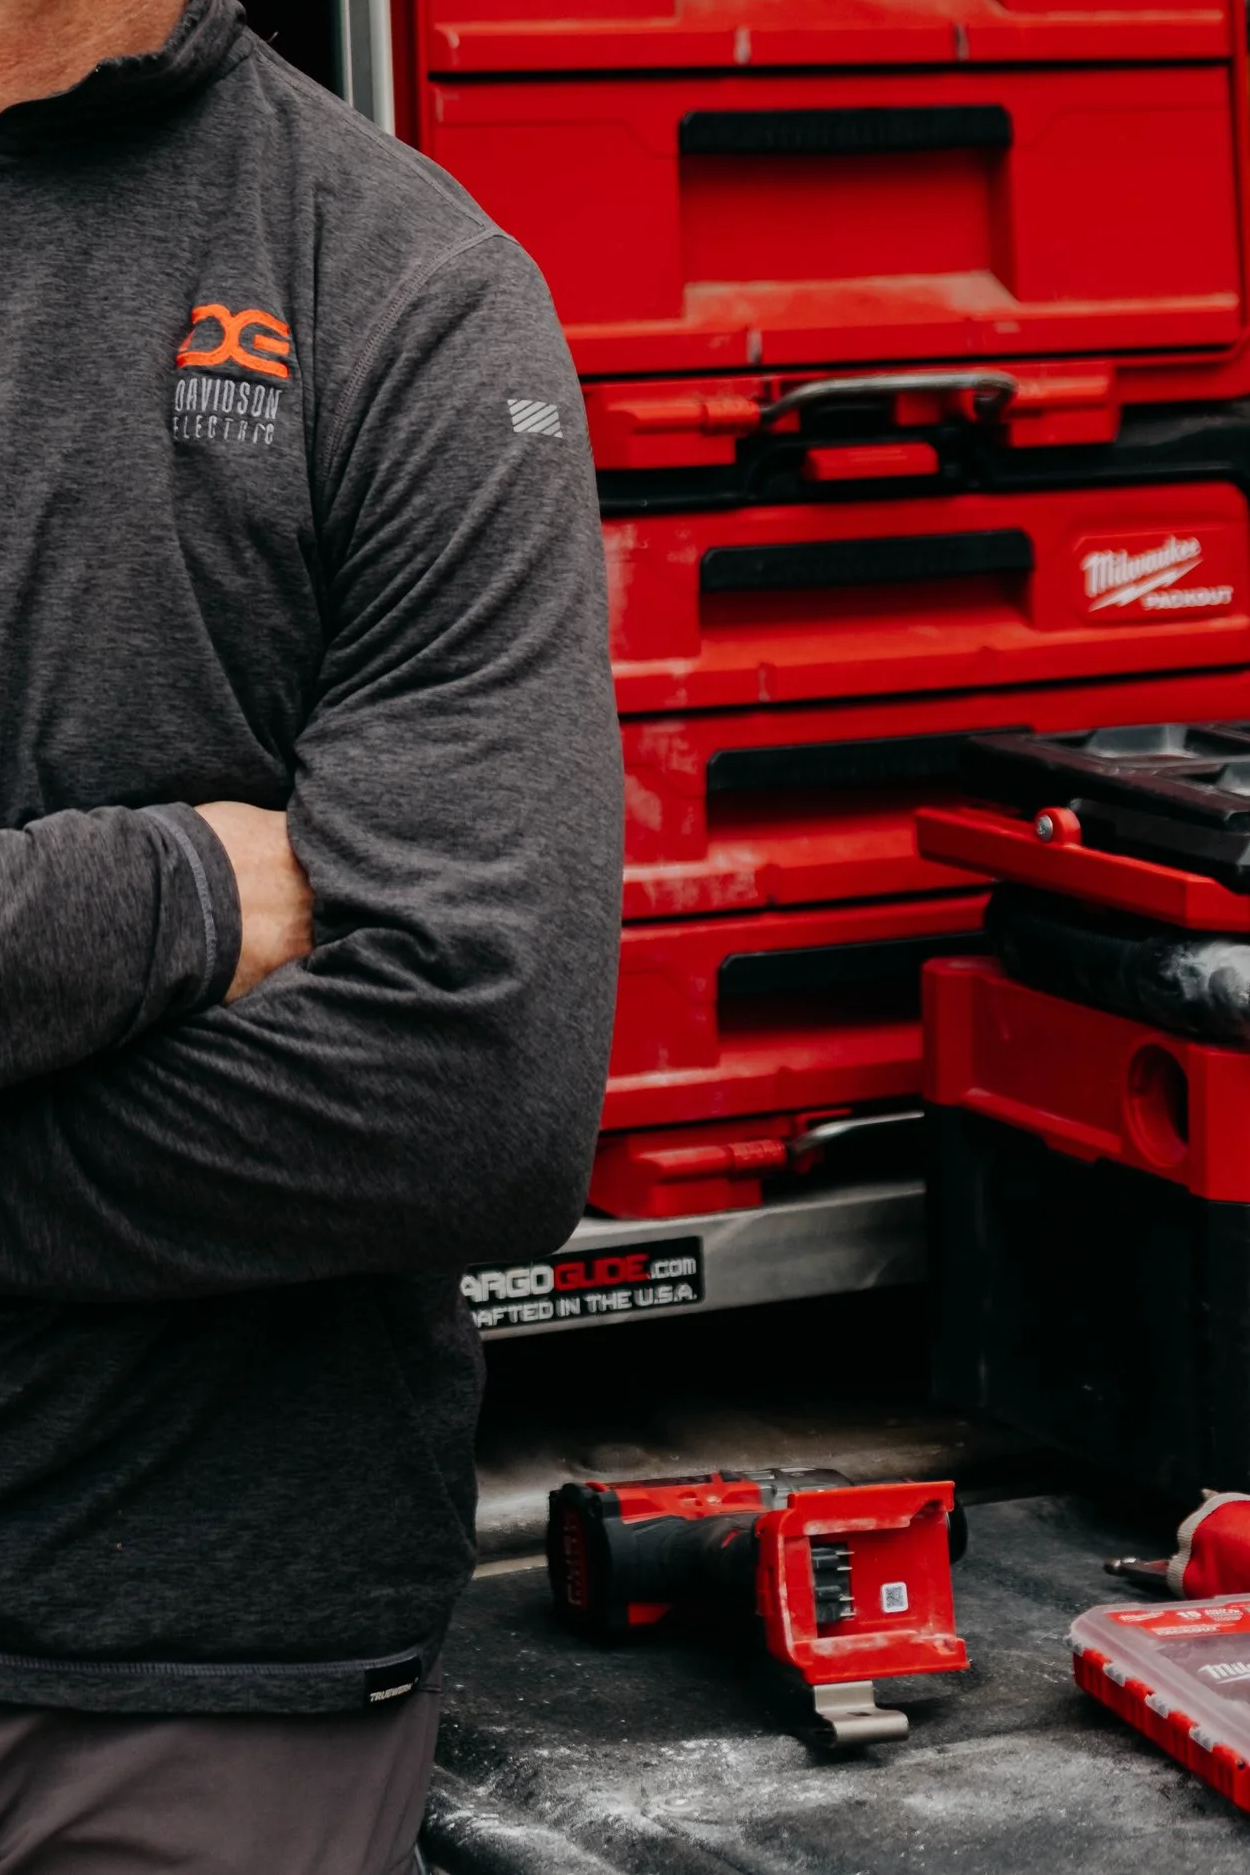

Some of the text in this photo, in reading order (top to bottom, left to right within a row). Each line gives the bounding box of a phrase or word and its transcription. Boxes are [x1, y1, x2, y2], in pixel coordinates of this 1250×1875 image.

[174, 377, 283, 420] DAVIDSON
[172, 415, 275, 445] ELECTRIC
[1081, 535, 1201, 598] Milwaukee
[1141, 585, 1234, 611] PACKOUT
[555, 1296, 581, 1317] IN
[583, 1290, 632, 1313] THE
